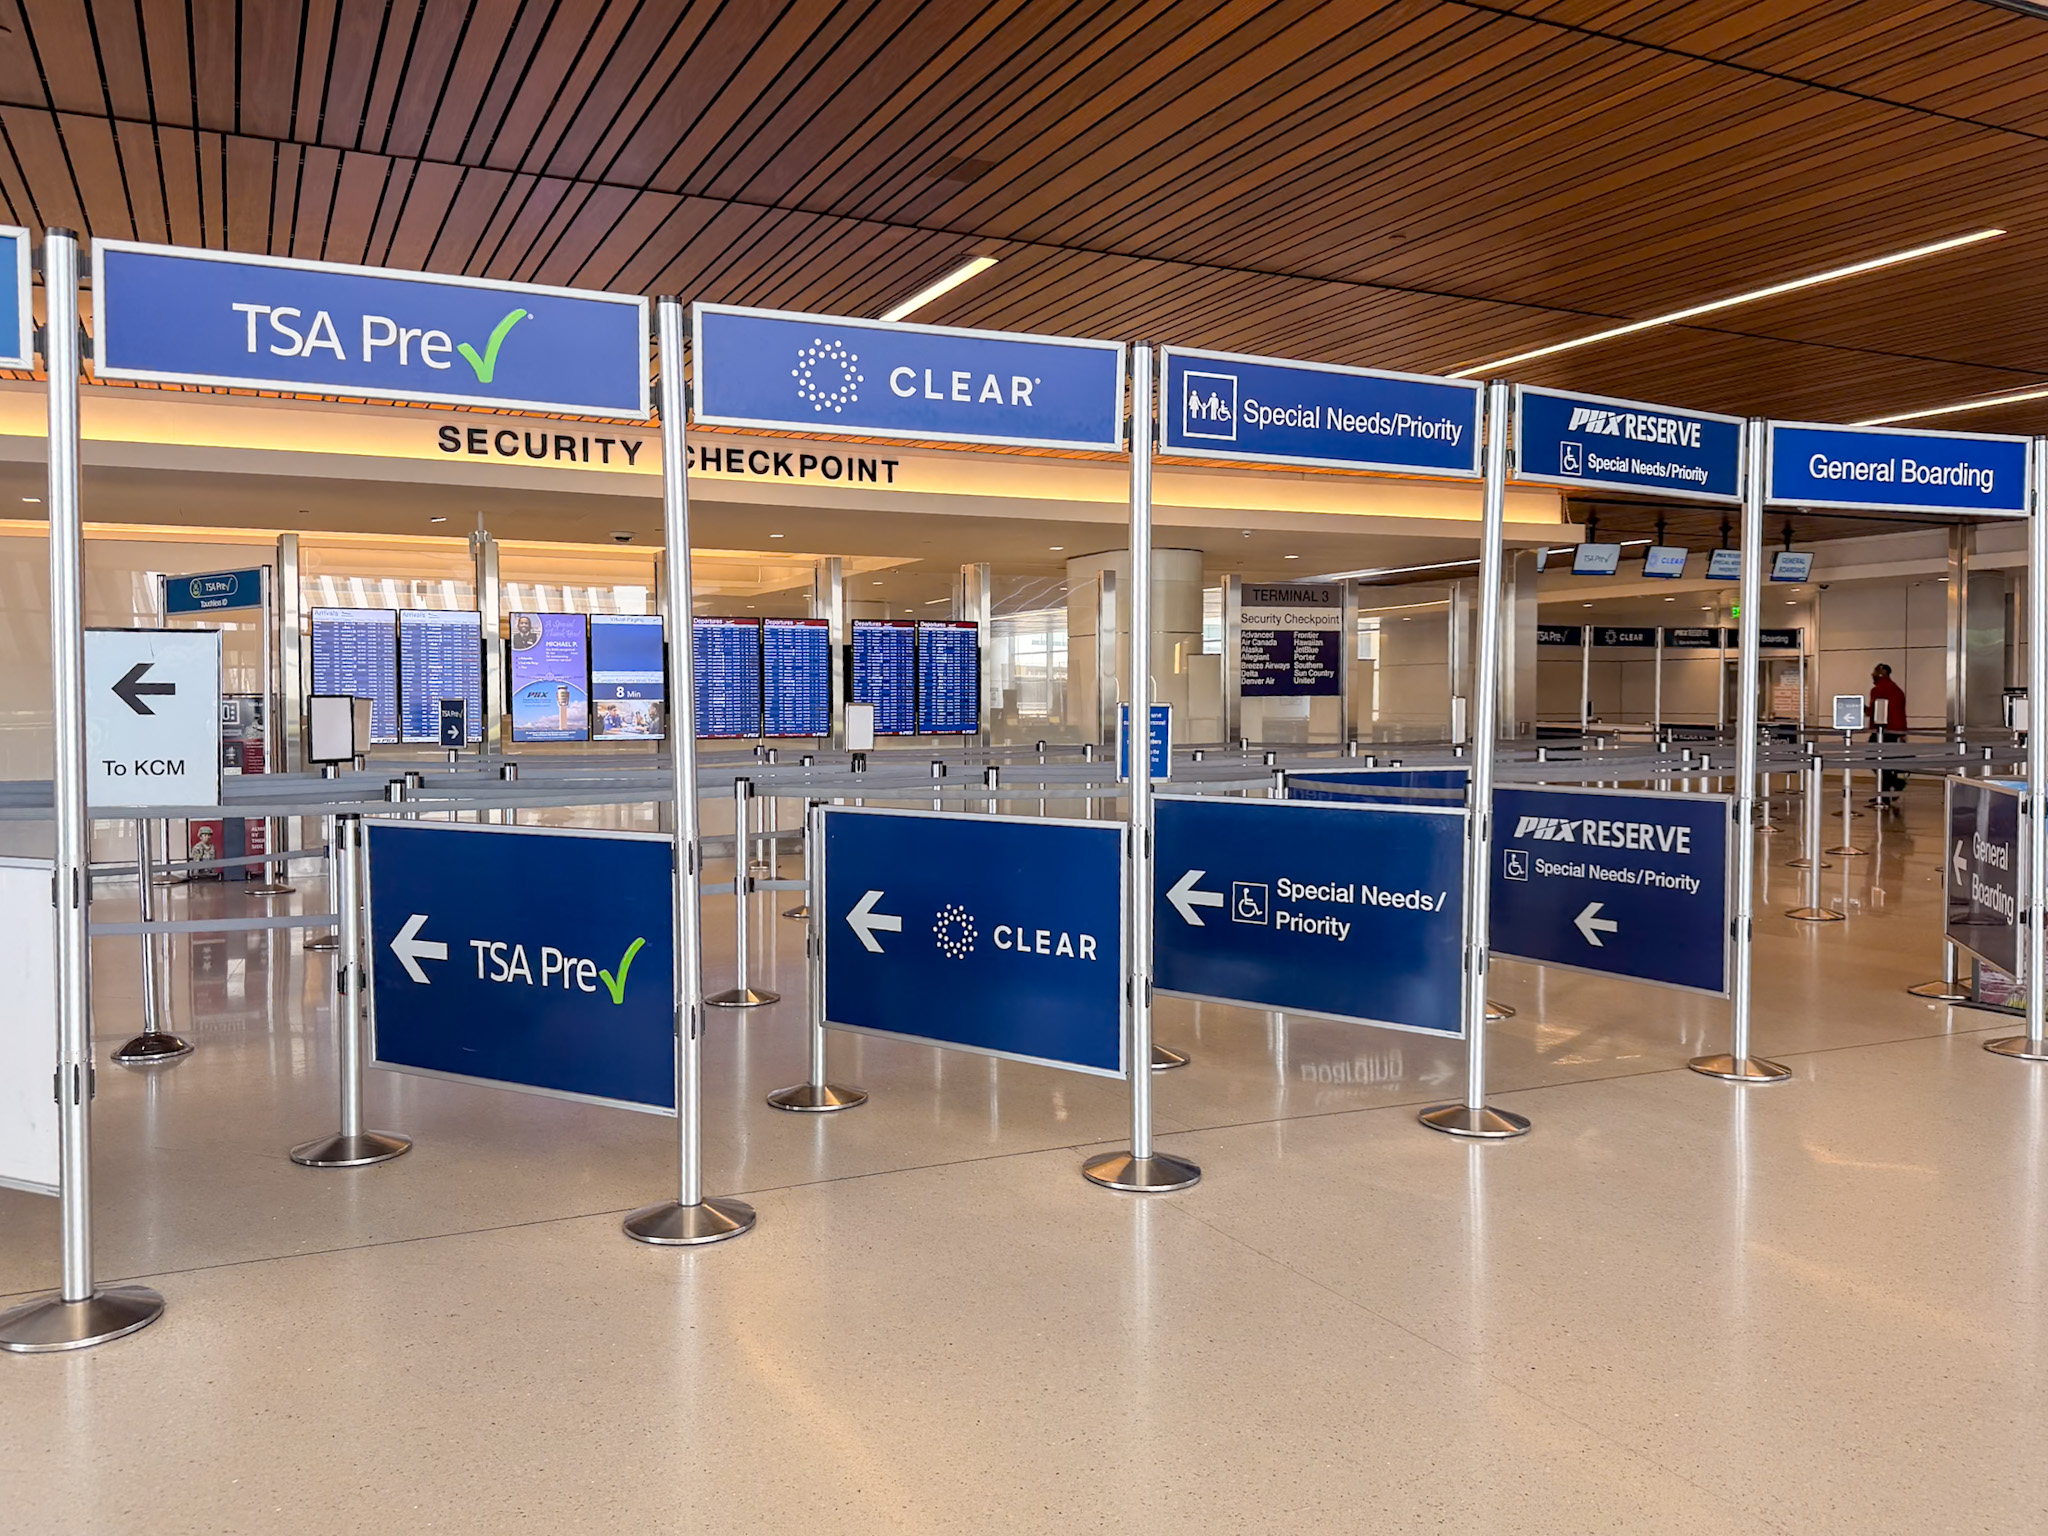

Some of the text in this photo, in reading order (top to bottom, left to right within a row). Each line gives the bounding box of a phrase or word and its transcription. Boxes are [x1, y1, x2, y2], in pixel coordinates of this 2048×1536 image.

[232, 302, 452, 369] TSA Pre
[889, 366, 1033, 407] CLEAR
[1243, 398, 1463, 447] Special Needs/Priority
[1568, 407, 1702, 448] PHX RESERVE
[438, 425, 643, 466] SECURITY
[1588, 453, 1709, 485] Special Needs/Priority
[1809, 453, 1995, 494] General Boarding
[1253, 589, 1329, 603] TERMINAL 3
[693, 617, 723, 625] Departures
[854, 620, 882, 628] Departures
[1241, 613, 1340, 627] Security Checkpoint
[1241, 631, 1274, 639] Advanced
[1293, 631, 1319, 639] Frontier
[1619, 633, 1643, 641] CLEAR
[1761, 635, 1789, 644] Boarding
[1241, 638, 1278, 646] Air Canada
[1241, 646, 1264, 654] Alaska
[1293, 646, 1319, 654] JetBlue
[1241, 653, 1270, 662] Allegiant
[1293, 653, 1316, 661] Porter
[1265, 662, 1291, 671] Airways
[1293, 662, 1324, 670] Southern
[1241, 670, 1259, 678] Delta
[1308, 670, 1335, 679] Country
[1241, 677, 1276, 685] Denver Air
[1293, 677, 1316, 685] United
[616, 686, 625, 698] 8
[102, 759, 185, 776] To KCM
[1513, 815, 1691, 855] PHX RESERVE
[1972, 831, 2009, 872] General
[1535, 858, 1701, 895] Special Needs/Priority
[1276, 877, 1447, 913] Special Needs/
[1971, 872, 2015, 926] Boarding
[1276, 911, 1351, 942] Priority
[993, 924, 1097, 961] CLEAR
[470, 939, 597, 993] TSA Pre
